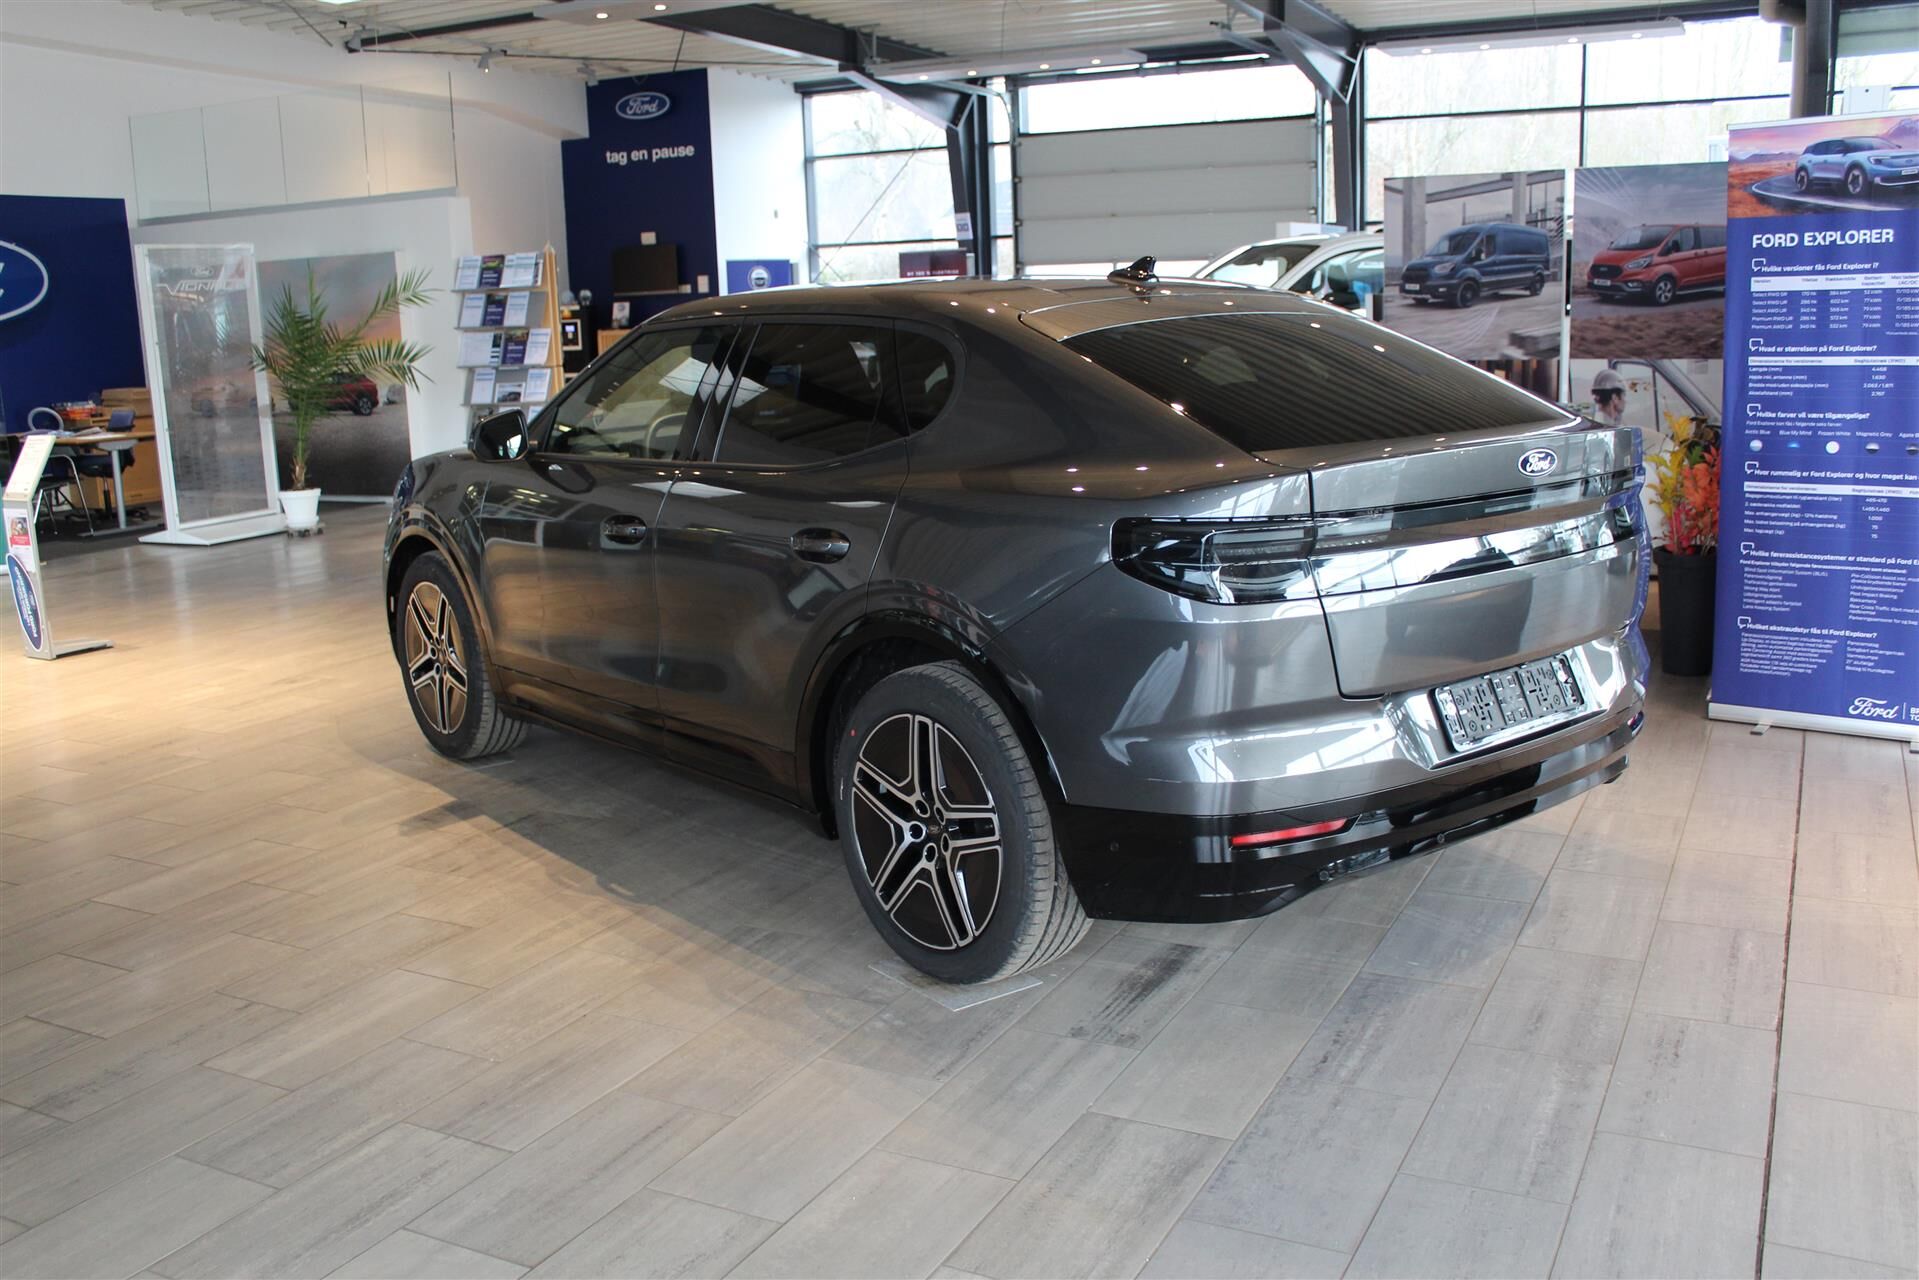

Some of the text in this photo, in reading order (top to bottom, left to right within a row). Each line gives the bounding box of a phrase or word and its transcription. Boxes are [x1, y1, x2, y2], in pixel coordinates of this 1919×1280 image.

[626, 96, 658, 114] Ford
[606, 145, 694, 165] tag en pause
[1753, 229, 1894, 248] FORD EXPLORER
[1843, 263, 1871, 271] Explorer
[1526, 453, 1551, 472] Ford
[1846, 630, 1877, 639] Explorer?
[1848, 697, 1899, 719] Ford
